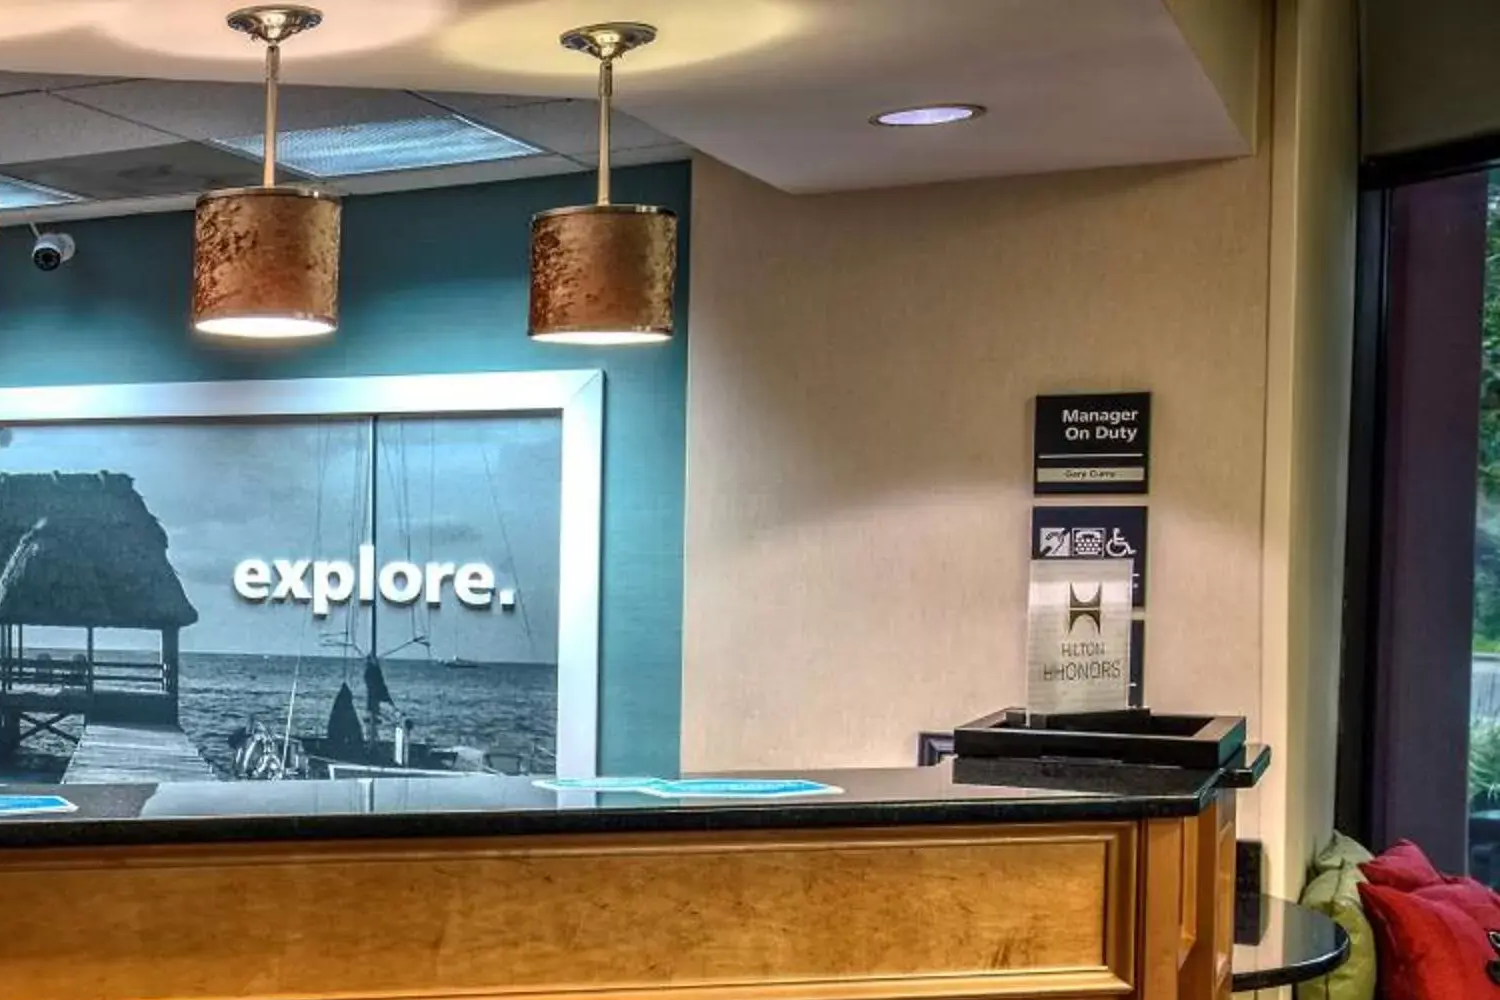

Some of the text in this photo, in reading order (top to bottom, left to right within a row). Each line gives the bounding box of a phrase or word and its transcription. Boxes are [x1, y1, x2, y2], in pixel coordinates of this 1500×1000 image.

[1061, 408, 1138, 425] Manager
[1064, 426, 1137, 443] On Duty
[233, 544, 515, 616] explore.
[1061, 642, 1106, 657] HILTON
